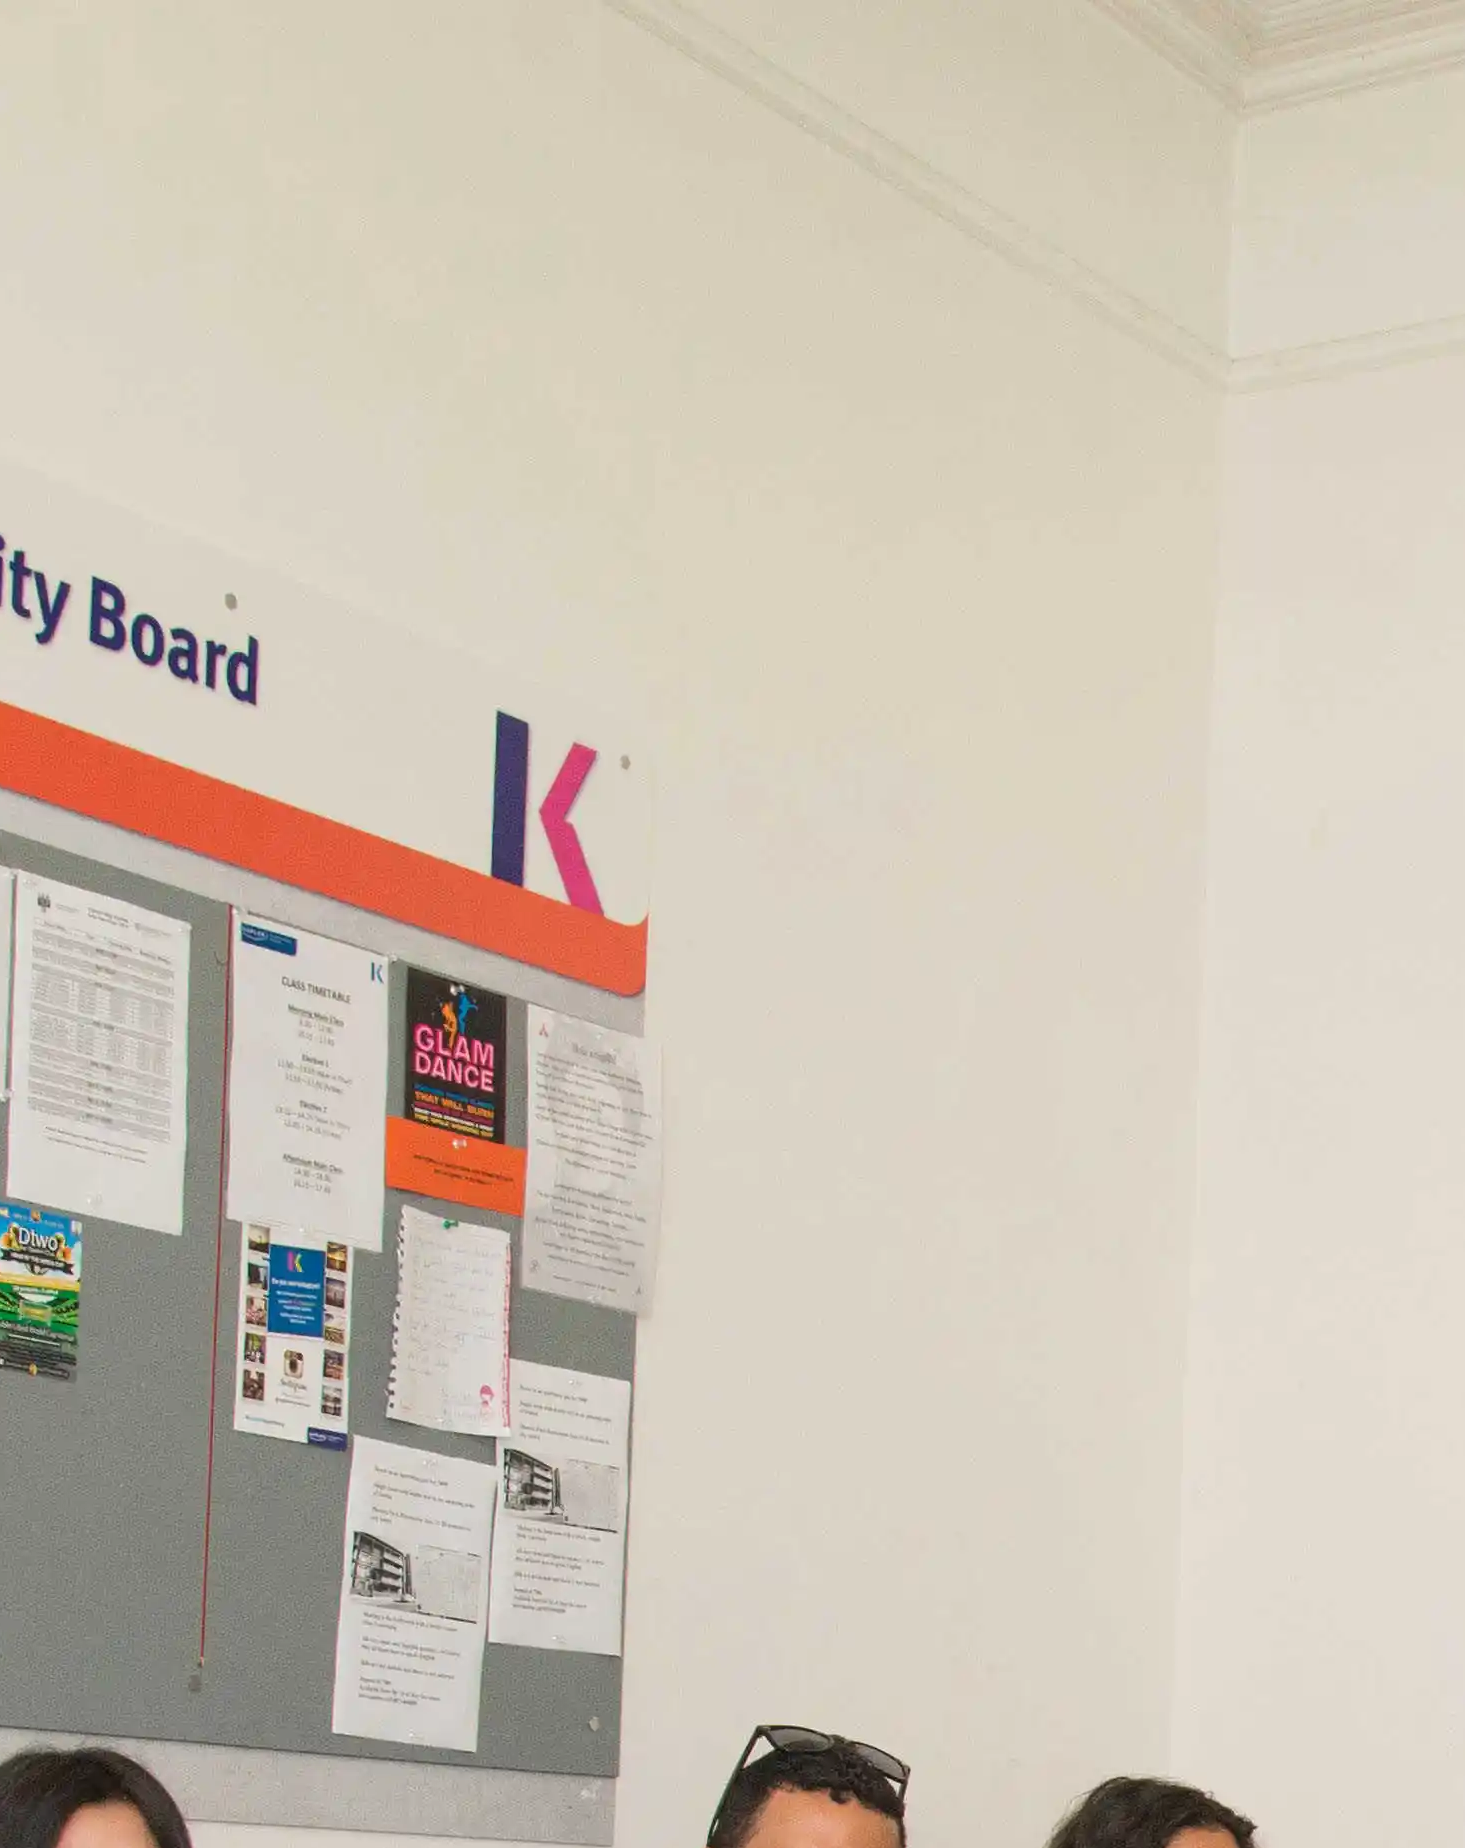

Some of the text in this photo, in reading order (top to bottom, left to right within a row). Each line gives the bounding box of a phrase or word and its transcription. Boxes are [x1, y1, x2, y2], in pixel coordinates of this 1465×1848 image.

[88, 576, 260, 705] Board
[490, 708, 605, 917] K
[281, 976, 352, 1004] CLASS TIMETABLE
[414, 1023, 495, 1069] GLAM
[414, 1051, 495, 1093] DANCE
[18, 1227, 59, 1252] Dtwo
